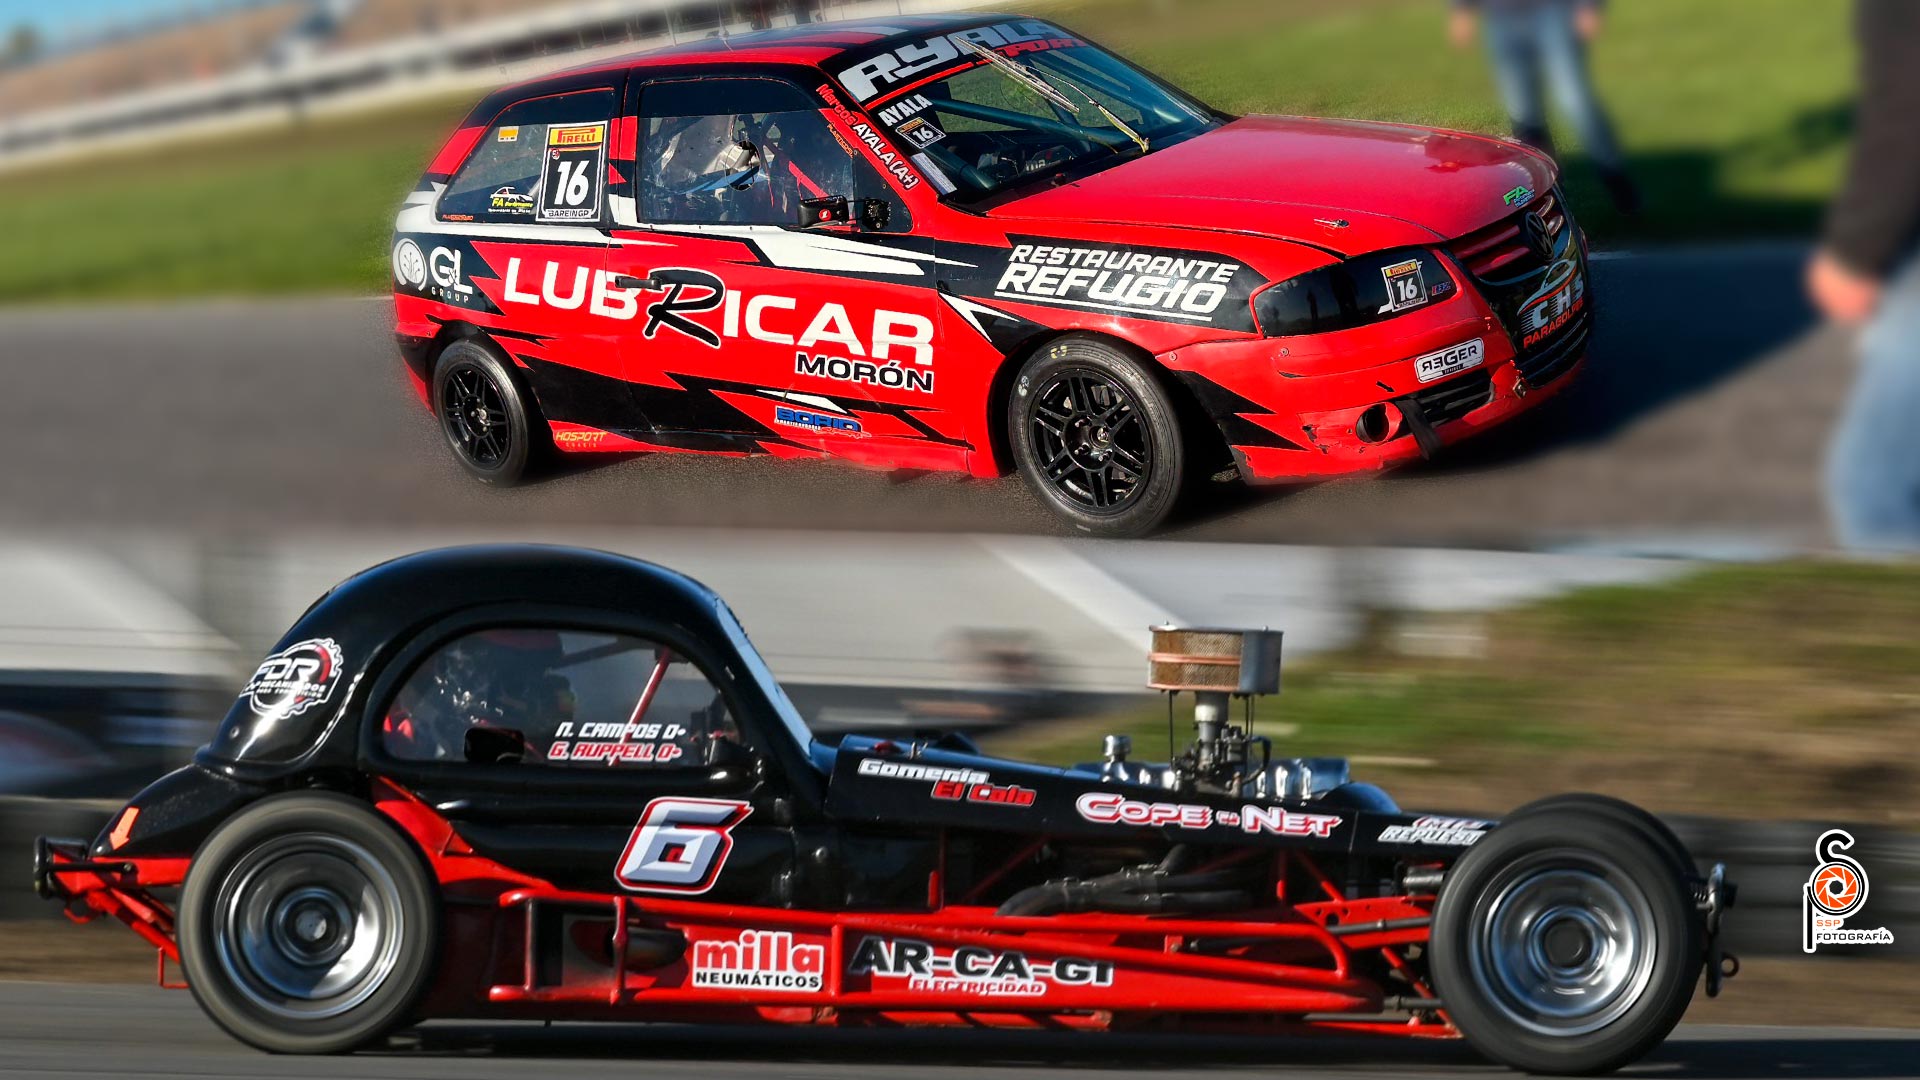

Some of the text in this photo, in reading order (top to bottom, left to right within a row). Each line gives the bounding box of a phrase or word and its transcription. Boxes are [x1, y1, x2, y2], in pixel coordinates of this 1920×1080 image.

[816, 83, 857, 126] Marcos
[878, 93, 933, 127] AYALA
[557, 127, 596, 144] PIRELLI
[912, 126, 935, 142] 16
[554, 160, 590, 206] 16
[1008, 244, 1240, 283] RESTAURANTE
[431, 286, 469, 303] GROUP
[996, 262, 1229, 314] REFUGIO
[1396, 277, 1418, 302] 16
[503, 256, 935, 366] LUBRICAR
[796, 352, 934, 393] MORÓN
[578, 722, 663, 739] CAMPOS
[570, 742, 656, 760] RUPPELL
[615, 796, 754, 894] 6
[696, 933, 821, 973] milla
[695, 971, 820, 988] NEUMÁTICOS
[911, 979, 1043, 994] ELECTRICIDAD
